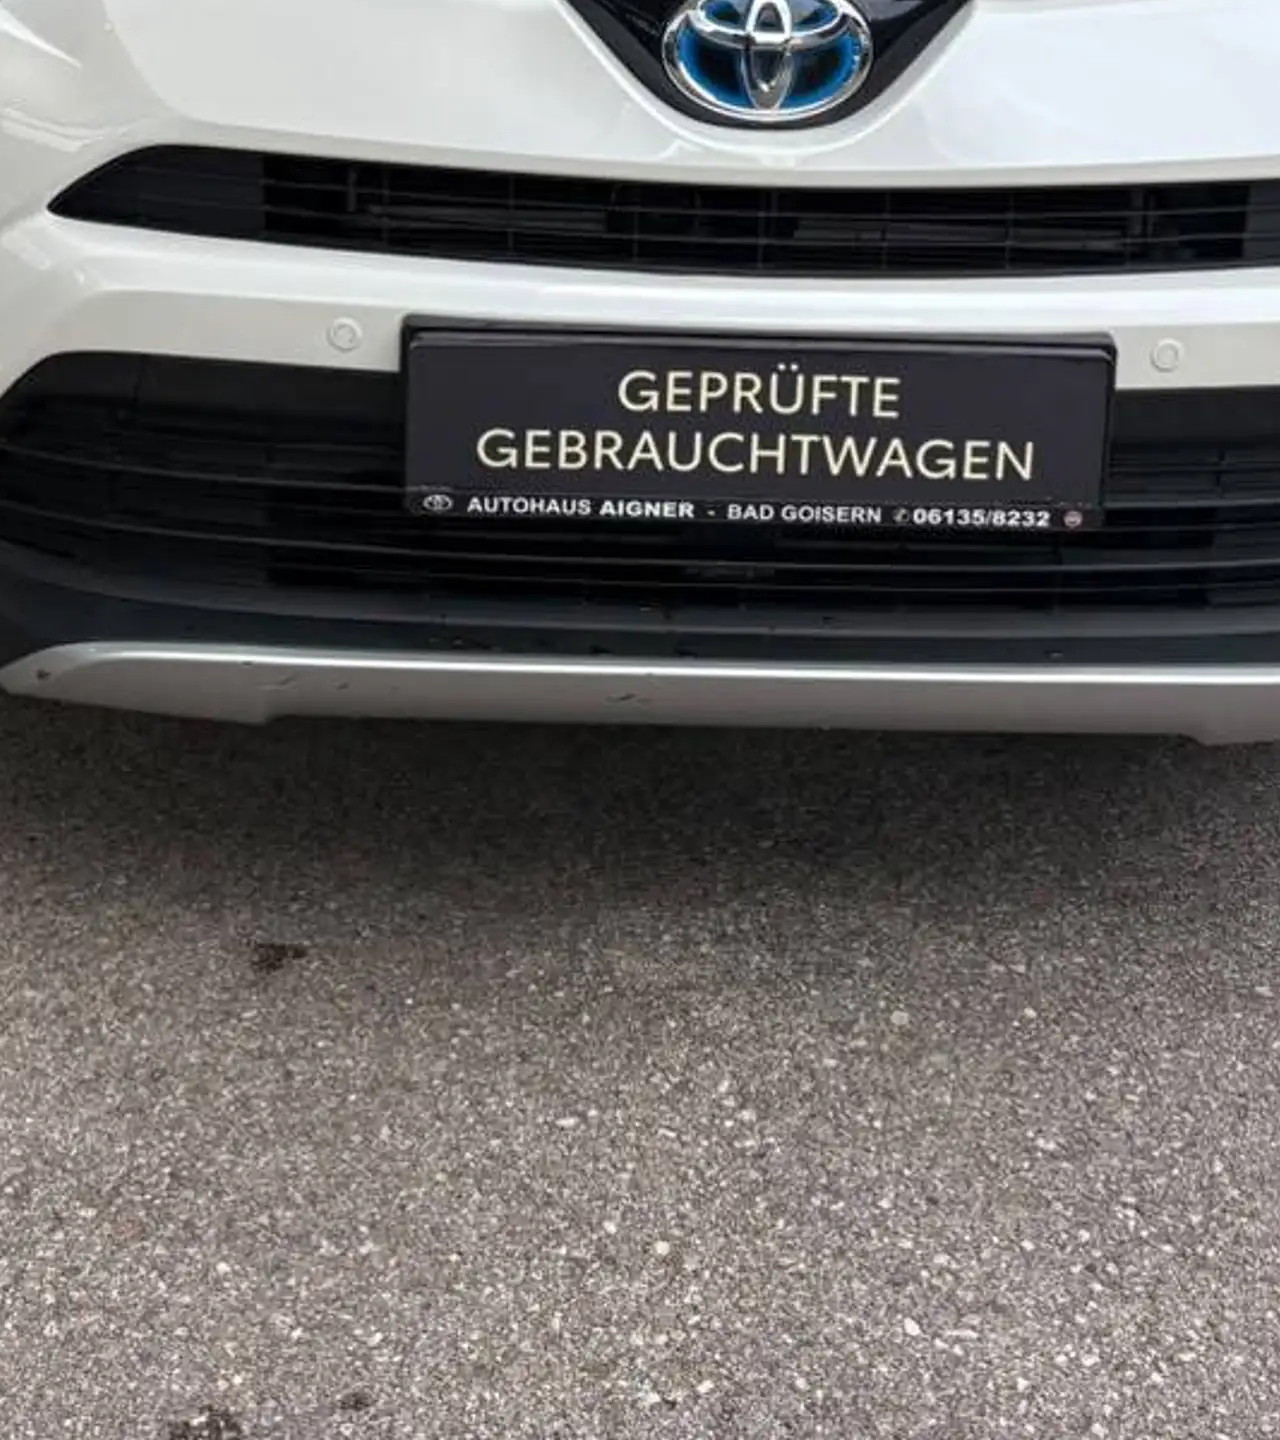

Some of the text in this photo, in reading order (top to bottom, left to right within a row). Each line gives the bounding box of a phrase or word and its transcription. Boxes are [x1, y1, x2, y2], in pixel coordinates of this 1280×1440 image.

[618, 362, 901, 418] GEPRÜFTE
[476, 428, 1034, 480] GEBRAUCHTWAGEN
[467, 496, 591, 516] AUTOHAUS
[599, 499, 695, 519] AIGNER
[727, 503, 775, 522] BAD
[781, 505, 882, 525] GOISERN
[912, 507, 1051, 528] 06135/8232
